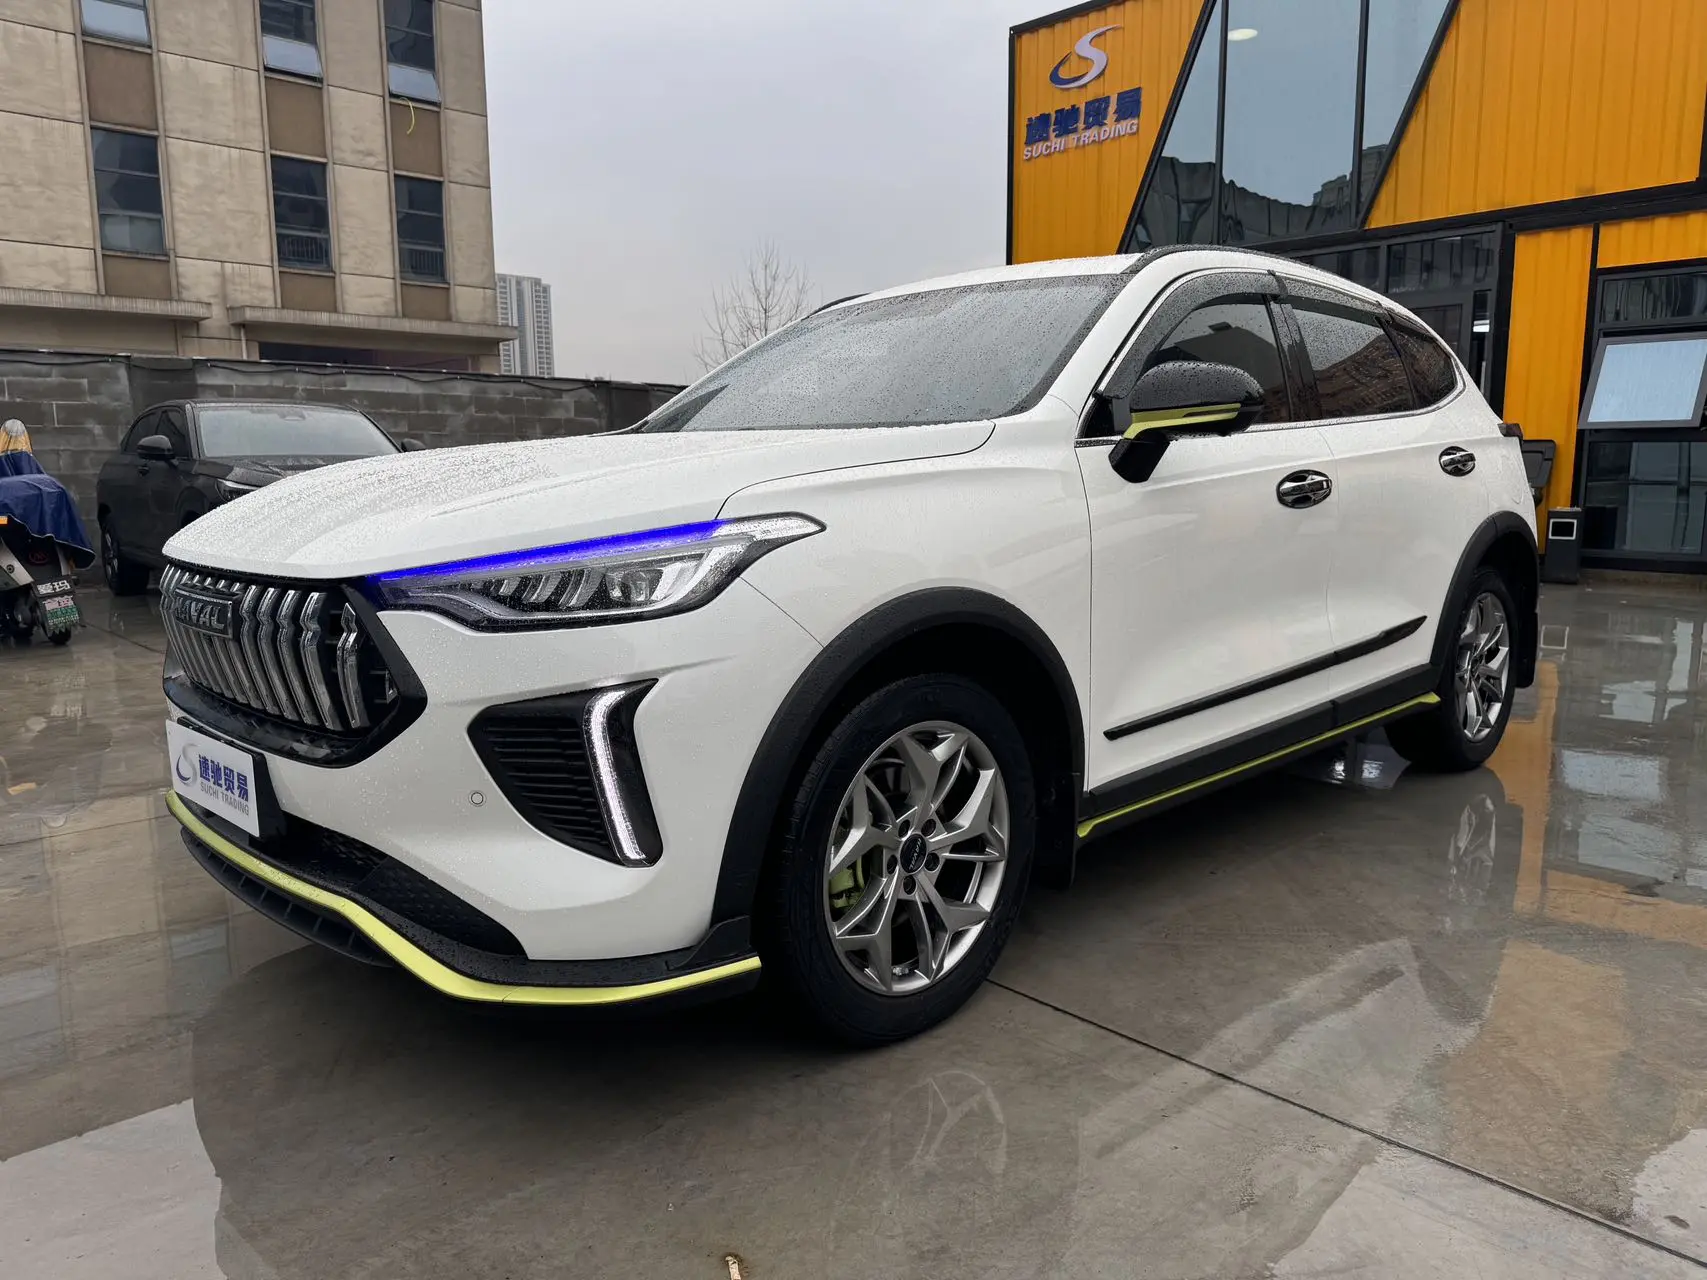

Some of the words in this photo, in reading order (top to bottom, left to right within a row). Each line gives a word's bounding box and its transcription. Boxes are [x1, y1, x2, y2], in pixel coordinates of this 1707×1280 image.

[1024, 87, 1142, 145] 速驰贸易
[1023, 138, 1066, 161] SUCHI
[1071, 120, 1138, 148] TRADING
[175, 596, 225, 630] HAVAL
[198, 754, 249, 802] 速驰贸易
[200, 781, 219, 800] SUCHI
[220, 791, 250, 816] TRADING
